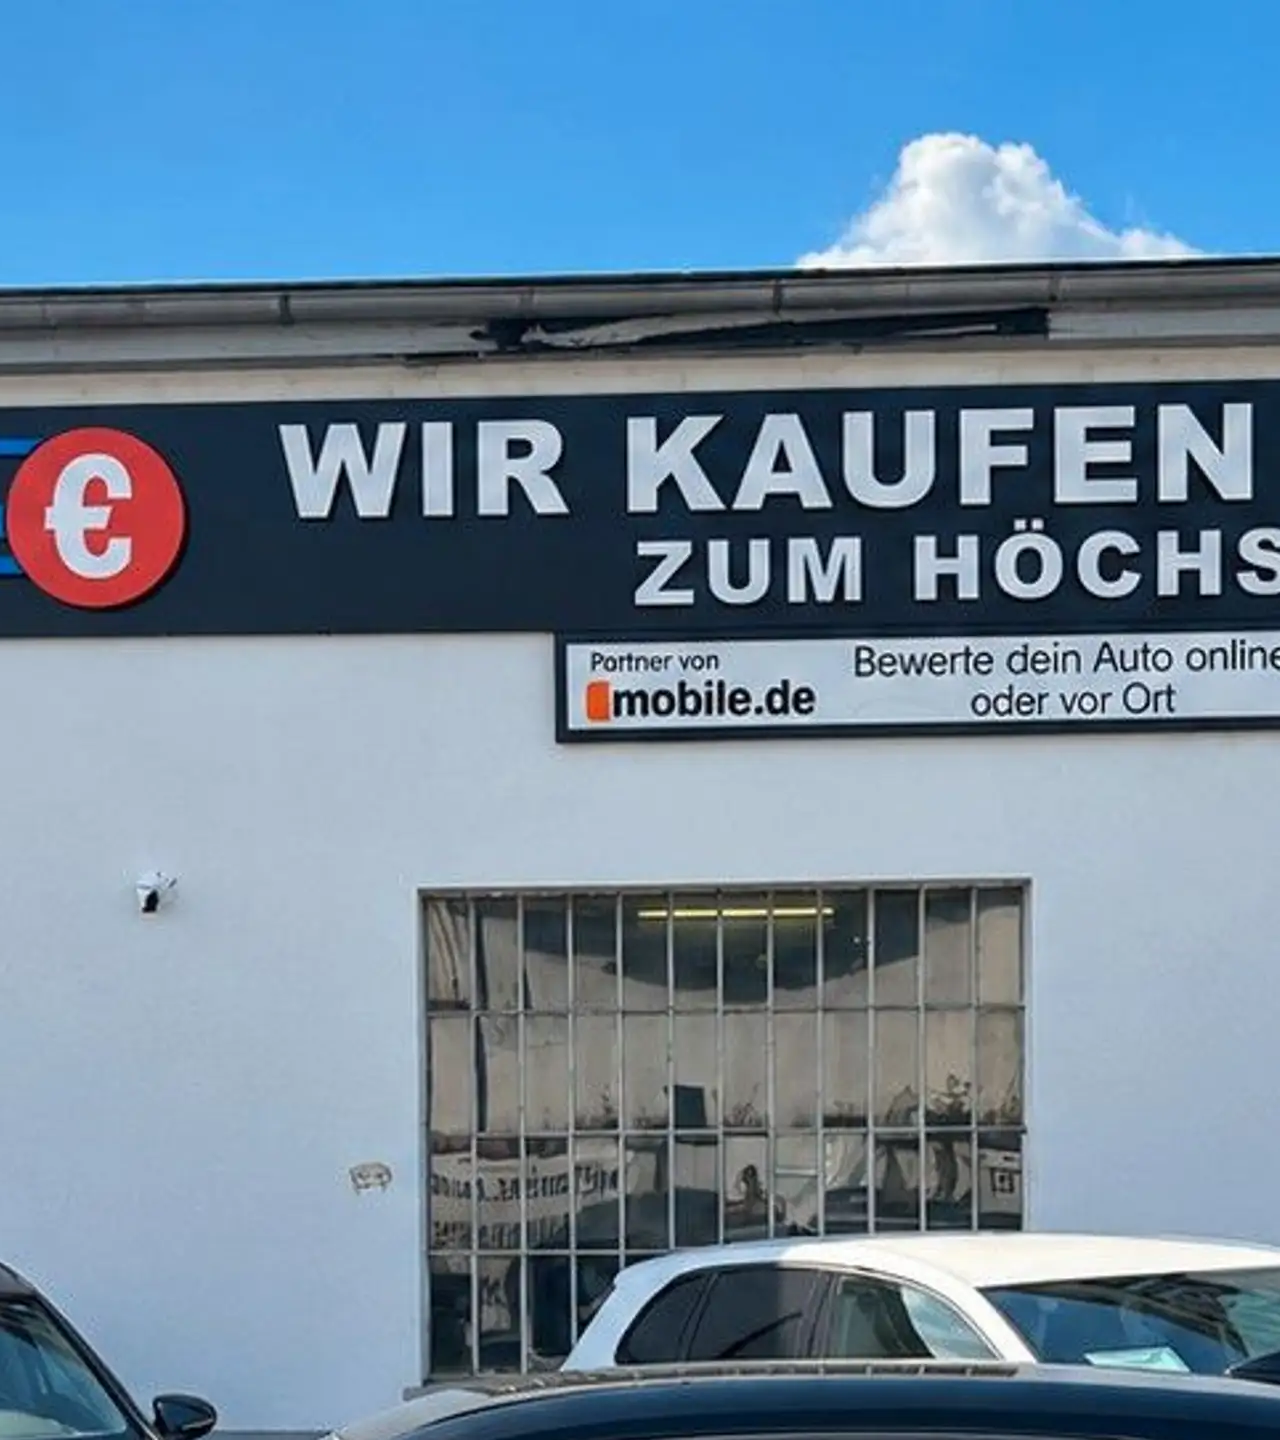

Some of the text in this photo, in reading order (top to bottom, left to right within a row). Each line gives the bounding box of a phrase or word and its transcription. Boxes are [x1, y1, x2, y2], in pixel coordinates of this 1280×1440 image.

[280, 418, 568, 518] WIR
[625, 402, 1254, 513] KAUFEN
[43, 452, 134, 580] €
[634, 536, 863, 606] ZUM
[591, 651, 720, 673] Partner von
[853, 645, 995, 678] Bewerte
[1005, 641, 1083, 676] dein
[1092, 640, 1175, 673] Auto
[612, 678, 817, 718] mobile.de
[970, 682, 1177, 717] oder vor Ort
